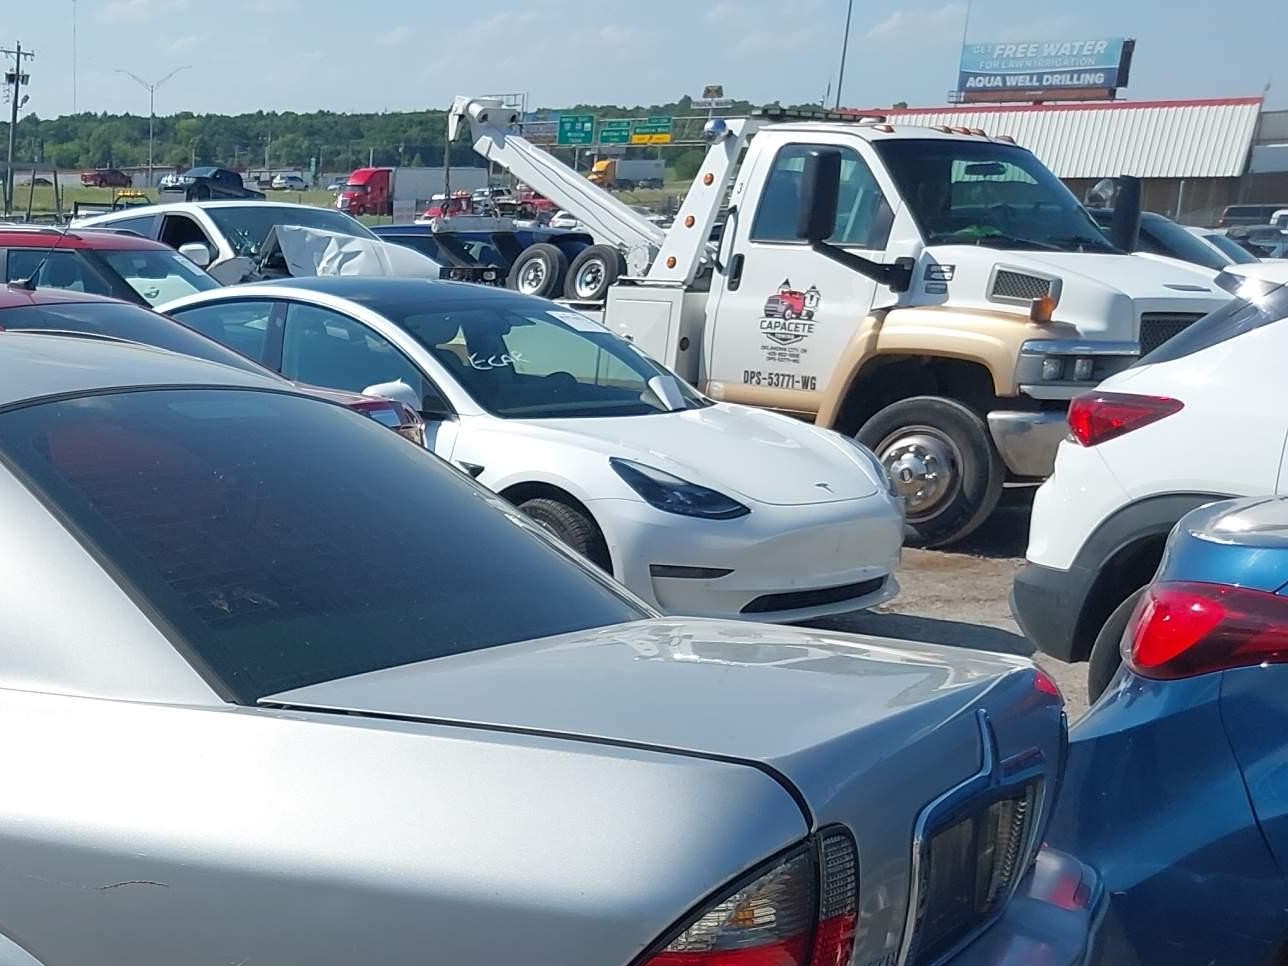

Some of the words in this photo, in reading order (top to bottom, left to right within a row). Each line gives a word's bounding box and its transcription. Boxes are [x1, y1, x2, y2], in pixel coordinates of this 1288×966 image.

[993, 43, 1039, 59] FREE
[1042, 40, 1108, 57] WATER
[978, 60, 1000, 70] FOR
[965, 76, 1003, 88] AQUA
[1005, 75, 1040, 87] WELL
[1042, 73, 1105, 86] DRILLING
[759, 320, 815, 333] CAPACETE
[743, 370, 817, 390] DPS-53771-WG
